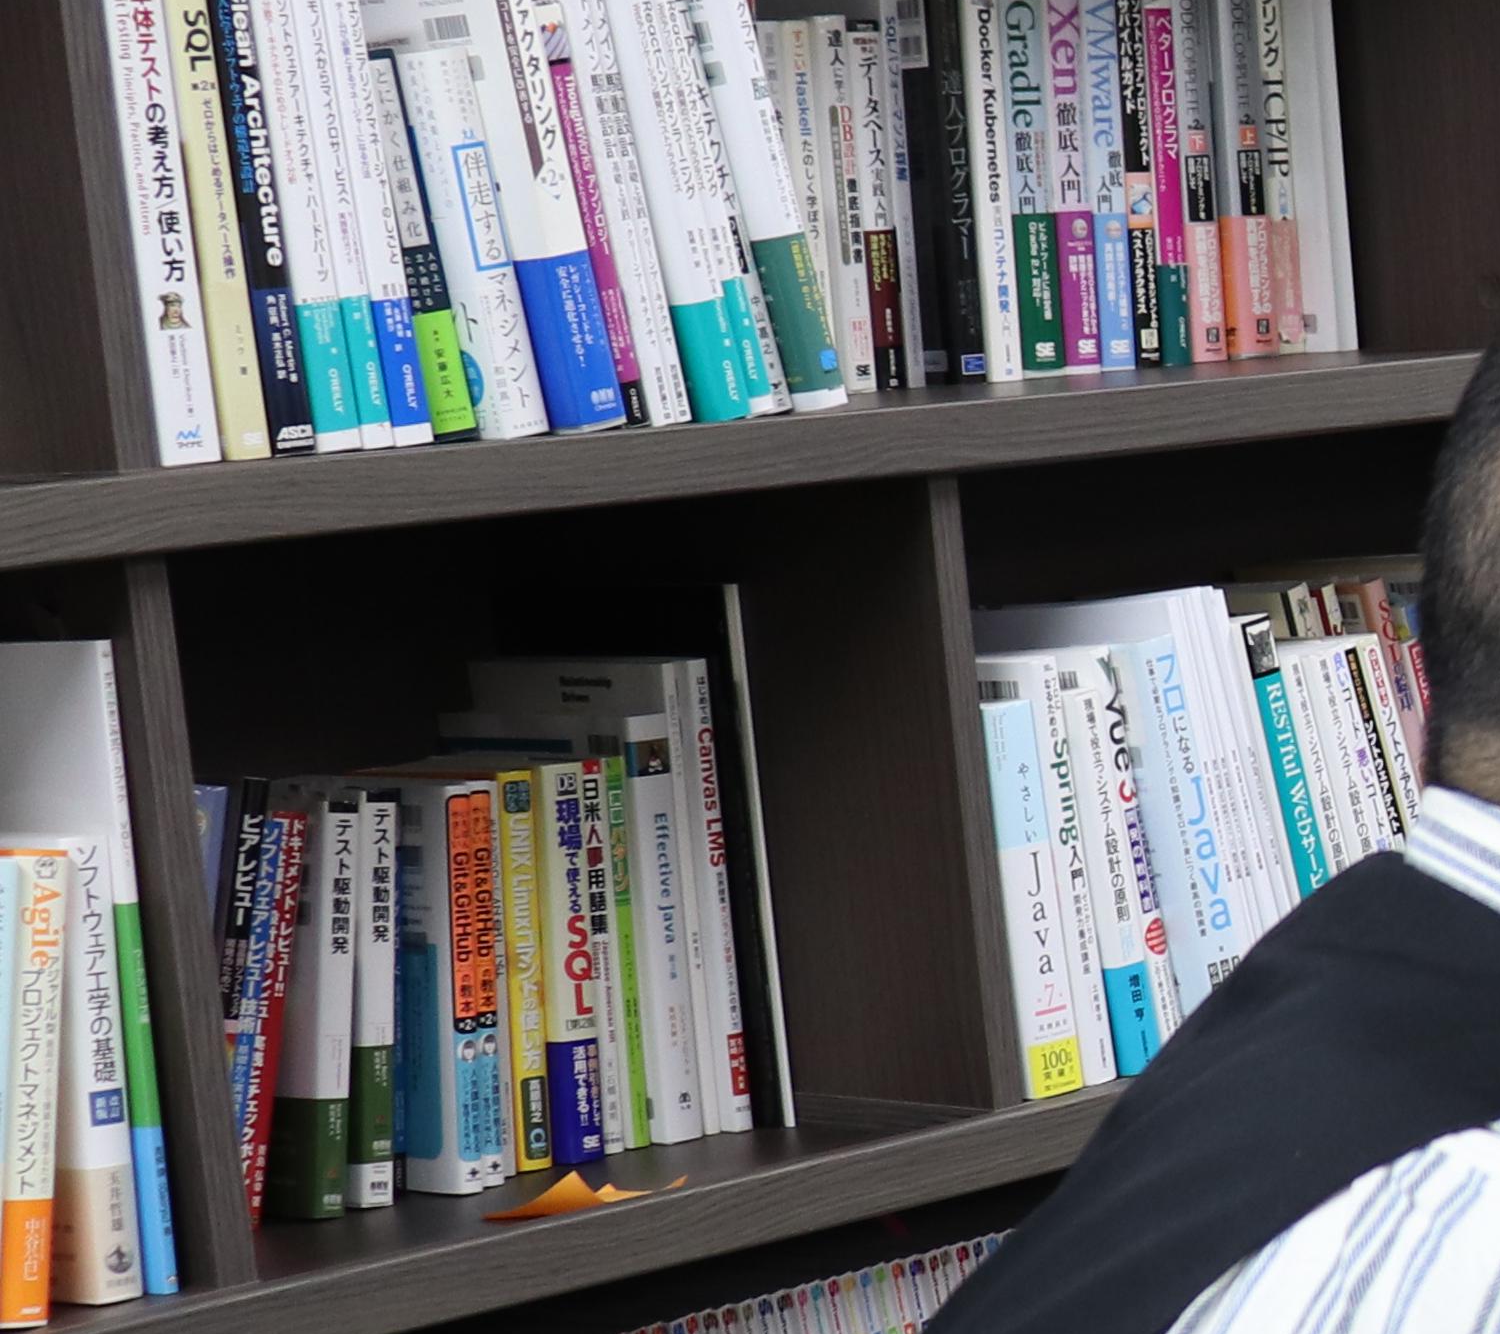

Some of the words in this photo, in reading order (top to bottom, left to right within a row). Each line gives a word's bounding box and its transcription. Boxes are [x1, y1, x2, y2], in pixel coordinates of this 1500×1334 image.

[115, 10, 132, 61] Testing
[183, 9, 212, 72] SQL
[1117, 0, 1136, 115] サバイバルガイド
[1155, 16, 1178, 159] ベタープログラマ
[1181, 38, 1201, 118] COMPLETE
[1232, 33, 1250, 113] COMPLETE
[306, 0, 350, 206] モノリスからマイクロサービスへ
[347, 0, 400, 266] エンジニアリングマネージャーのしごと
[375, 66, 424, 239] とにかく仕組み化
[858, 55, 888, 227] データベース実践入門
[241, 73, 284, 267] Architecture
[941, 70, 974, 260] 達人プログラマー
[1131, 230, 1149, 315] ベストプラクティス
[436, 348, 456, 401] 安藤広大
[697, 727, 717, 812] Canvas
[1266, 681, 1302, 779] RESTful
[705, 817, 726, 868] LMS
[1082, 697, 1131, 925] 現場で役立つシステム設計の原則
[1119, 778, 1137, 804] 3
[233, 813, 264, 927] ピアレビュー
[330, 818, 353, 955] テスト駆動開発
[371, 807, 391, 944] テスト駆動開発
[582, 778, 609, 935] 日米人事用語集
[654, 812, 673, 899] Effective
[20, 881, 62, 969] Agile
[76, 845, 119, 1083] ソフトウェア工学の基礎
[657, 904, 676, 945] Java
[16, 969, 43, 1196] プロジェクトマネジメント
